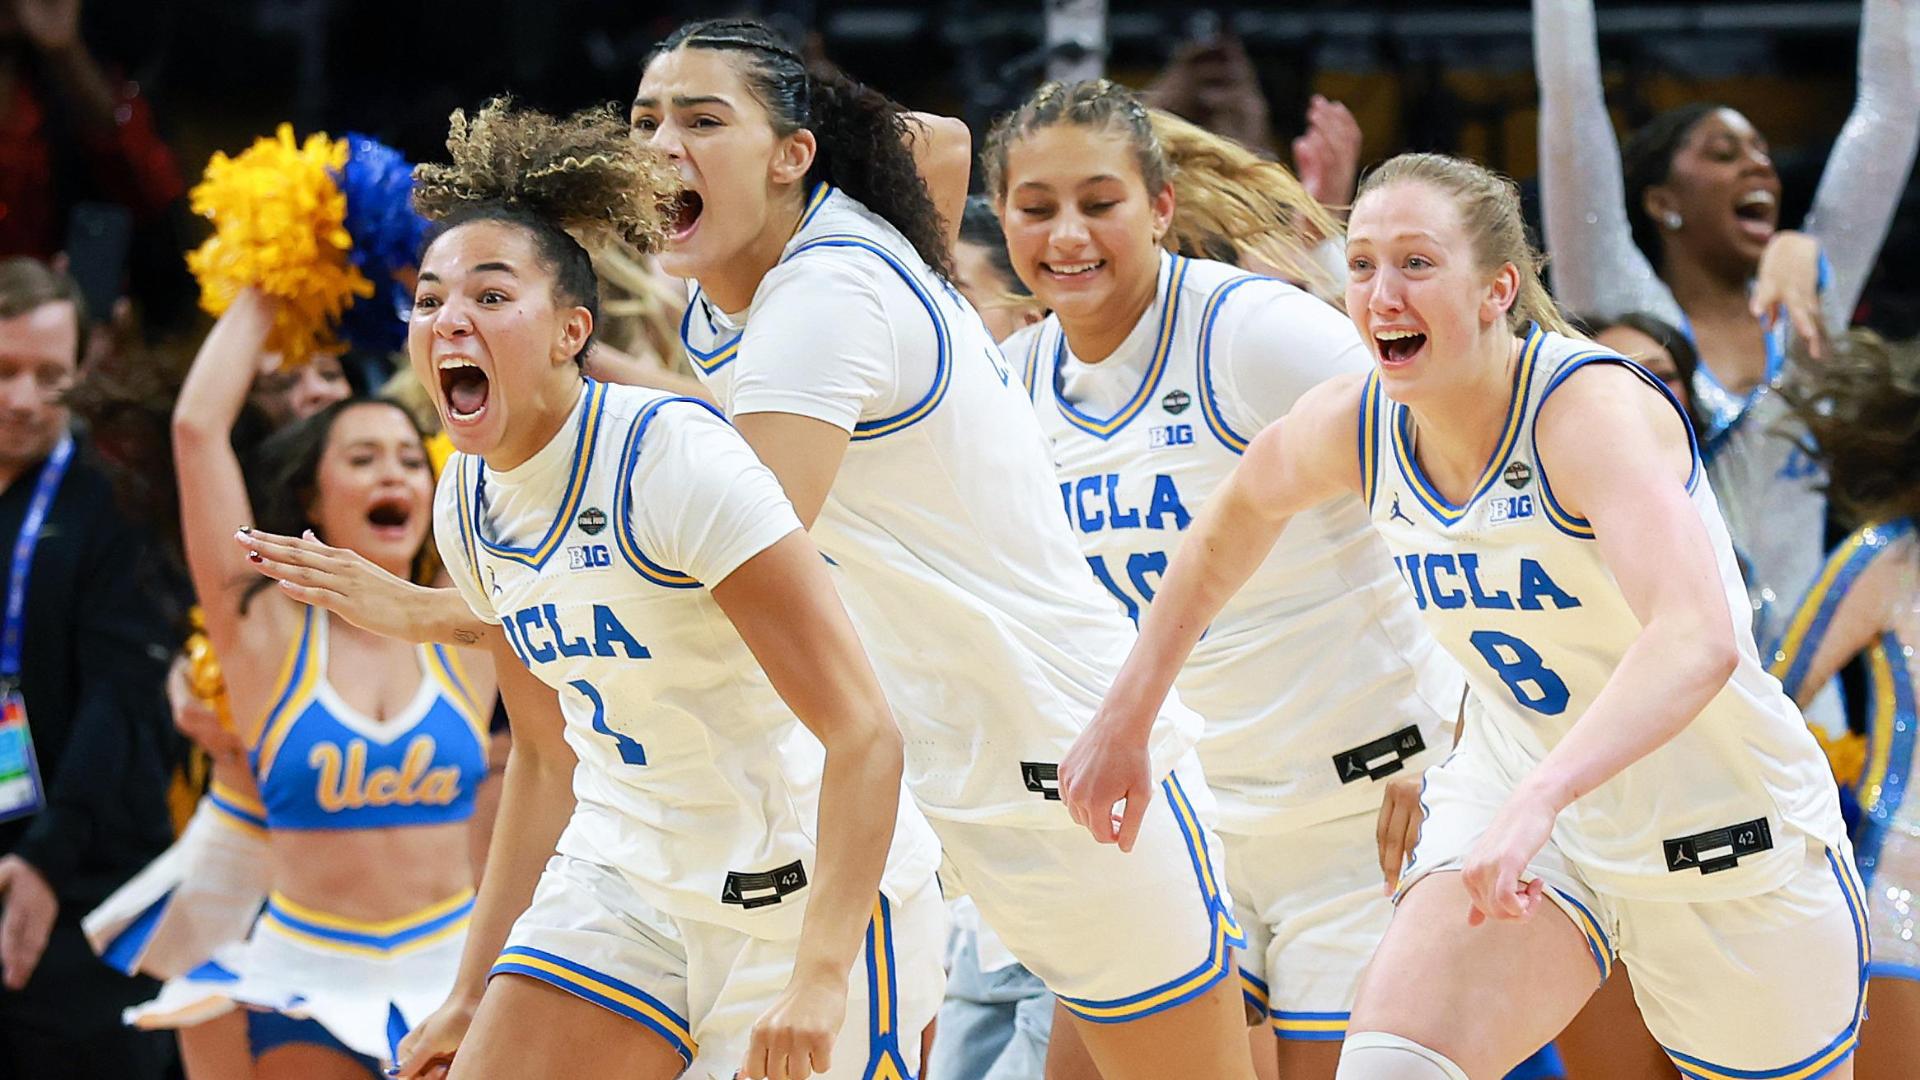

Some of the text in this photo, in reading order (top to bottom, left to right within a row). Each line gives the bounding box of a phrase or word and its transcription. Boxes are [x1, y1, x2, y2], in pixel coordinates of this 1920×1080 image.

[1469, 630, 1571, 716] 8
[566, 679, 647, 766] 1
[309, 735, 461, 812] Ucla
[1738, 830, 1755, 846] 42
[781, 871, 799, 886] 42
